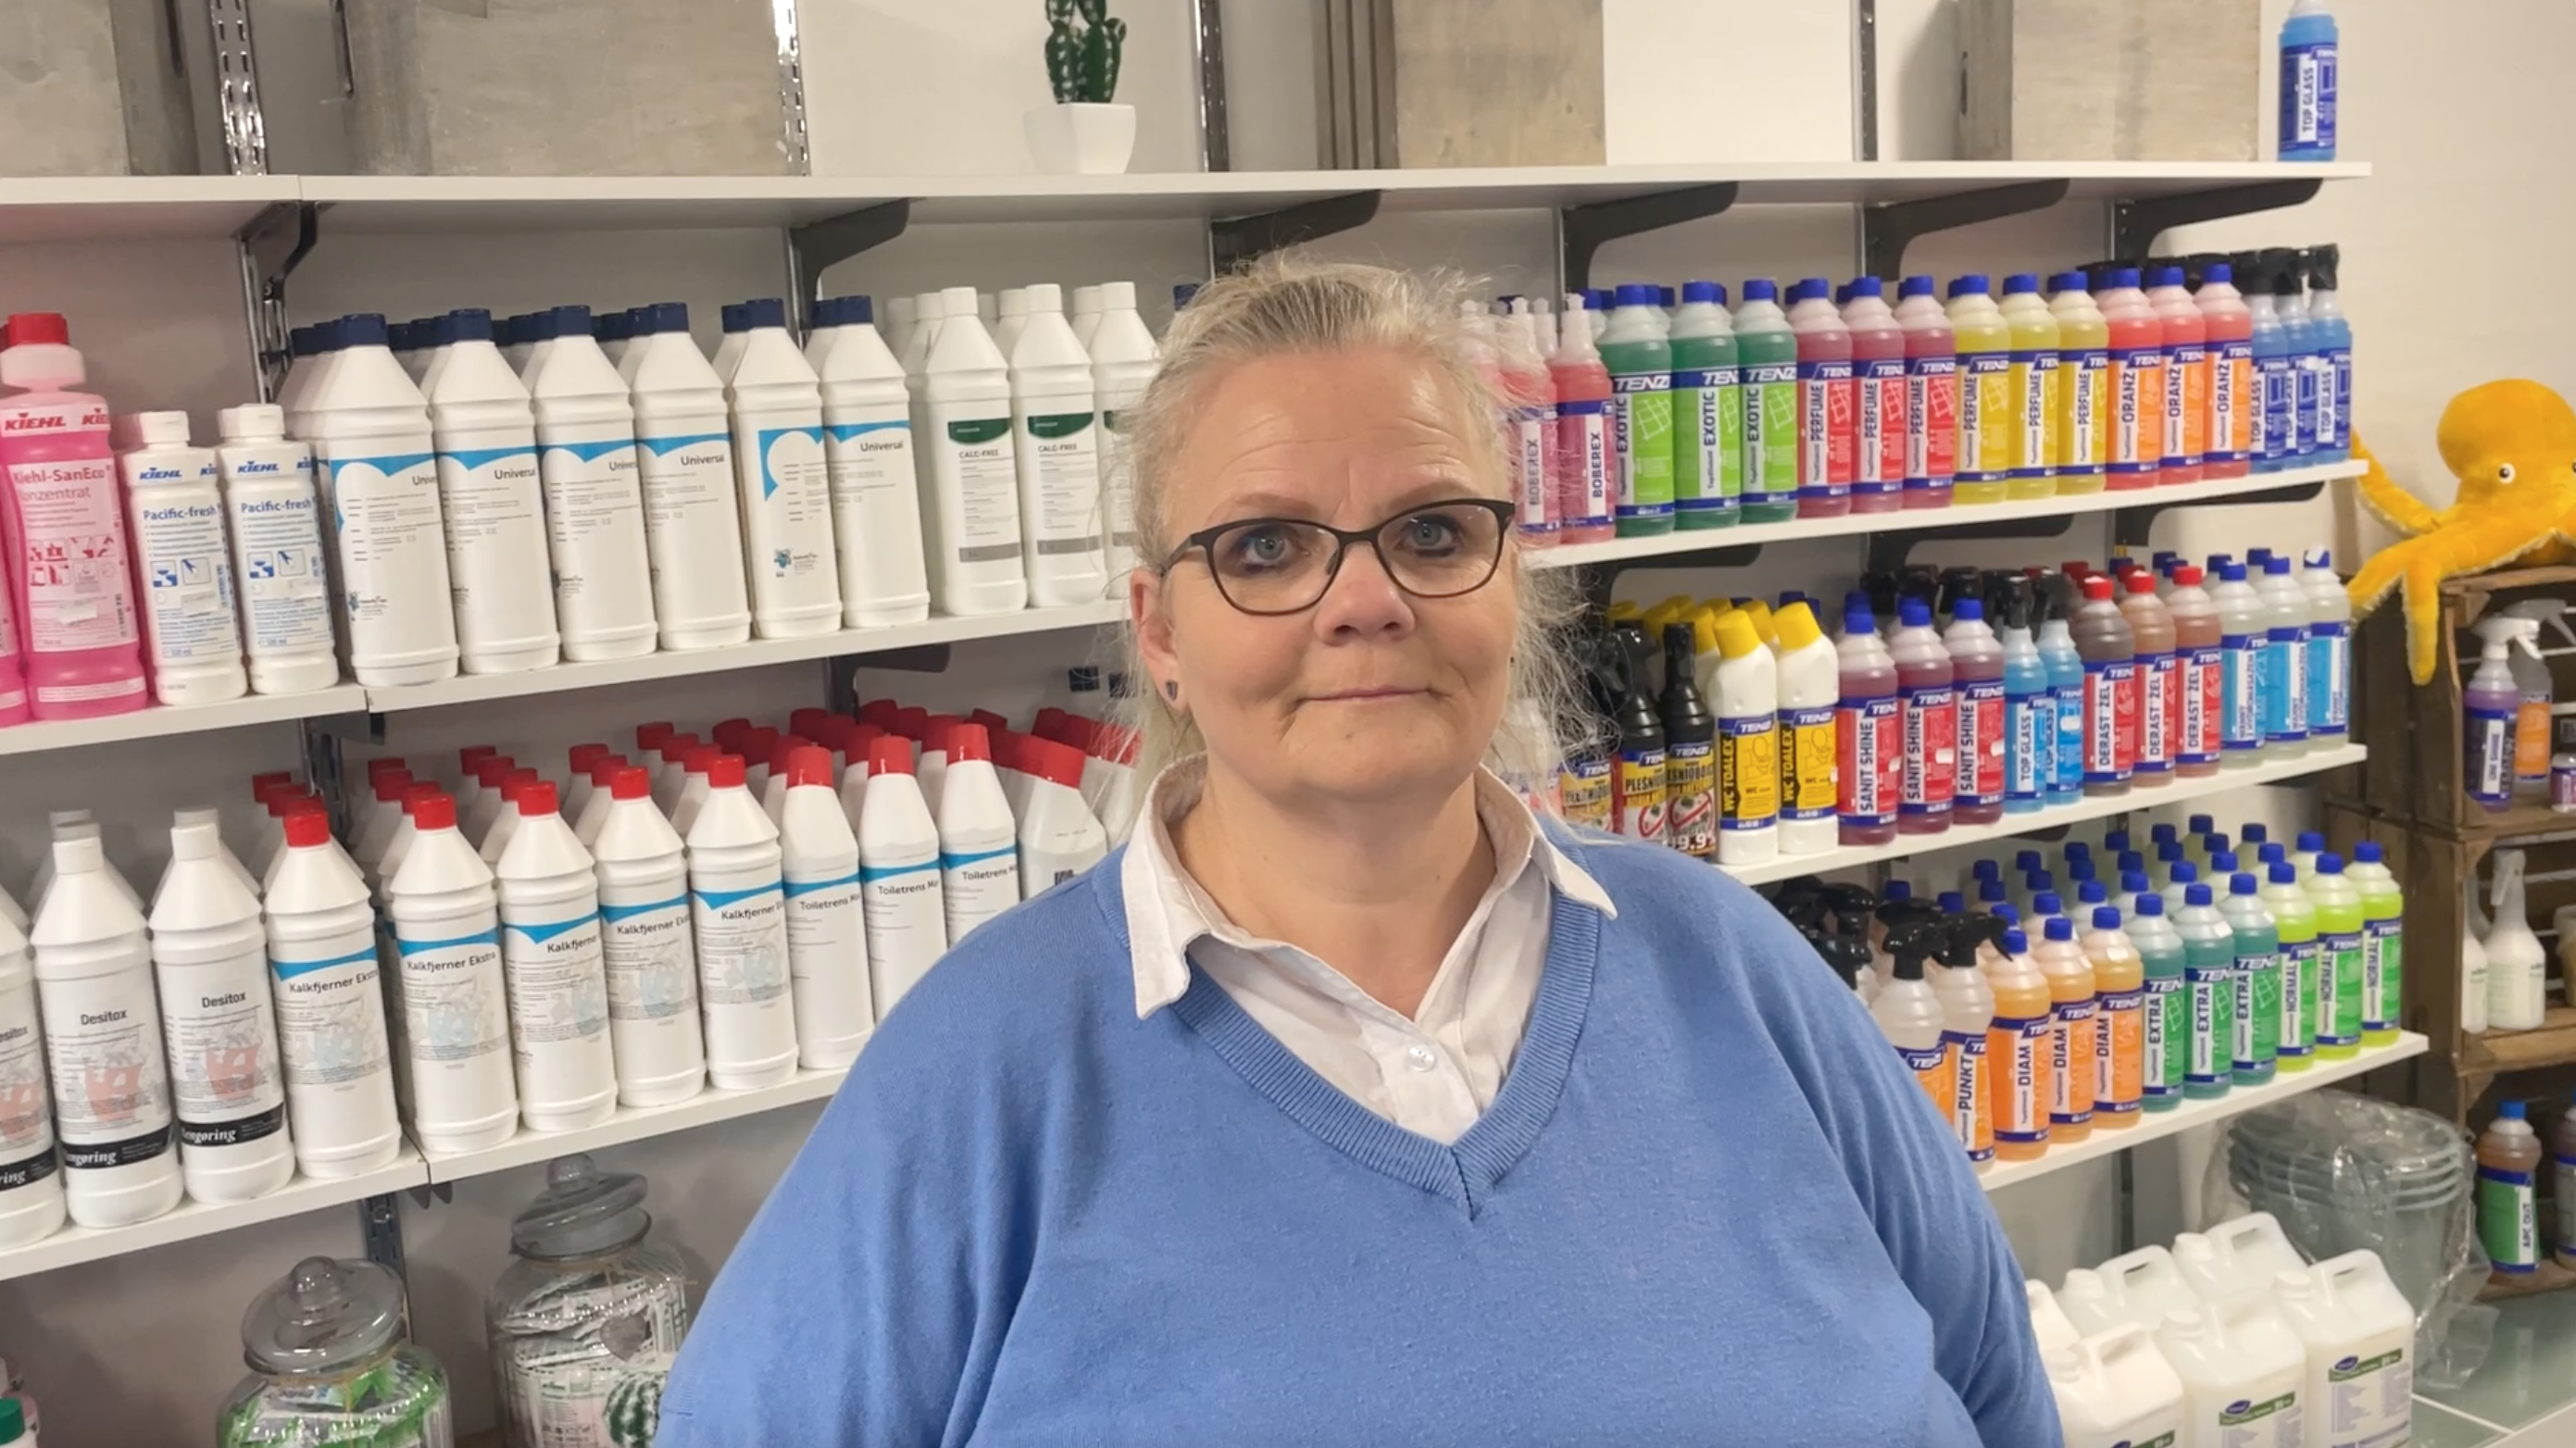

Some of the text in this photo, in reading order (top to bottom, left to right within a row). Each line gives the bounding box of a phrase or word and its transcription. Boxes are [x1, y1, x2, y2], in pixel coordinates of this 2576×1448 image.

[5, 412, 67, 431] KIEHL
[1616, 398, 1629, 454] EXOTIC
[1703, 390, 1717, 447] EXOTIC
[1746, 388, 1759, 443] EXOTIC
[1590, 431, 1604, 498] BOBEREX
[144, 505, 218, 521] Pacific-fresh
[241, 498, 312, 514] Pacific-fresh
[1860, 721, 1874, 812] SANIT SHINE
[1907, 710, 1920, 800] SANIT SHINE
[1960, 704, 1974, 792] SANIT SHINE
[2020, 715, 2032, 781] TOP GLASS
[878, 884, 926, 896] Toiletrens
[962, 868, 1007, 881] Toiletrens
[720, 904, 775, 921] Kalkfjerner
[799, 897, 849, 911] Toiletrens
[617, 918, 674, 937] Kalkfjerner
[289, 976, 354, 994] Kalkfjerner
[406, 959, 466, 974] Kalkfjerner
[201, 991, 246, 1008] Desitox
[2196, 986, 2209, 1033] EXTRA
[2235, 974, 2249, 1020] EXTRA
[80, 1009, 128, 1026] Desitox
[2096, 1017, 2109, 1057] DIAM
[2148, 996, 2161, 1044] EXTRA
[2018, 1044, 2032, 1087] DIAM
[2053, 1028, 2067, 1068] DIAM
[1958, 1055, 1974, 1111] PUNKT
